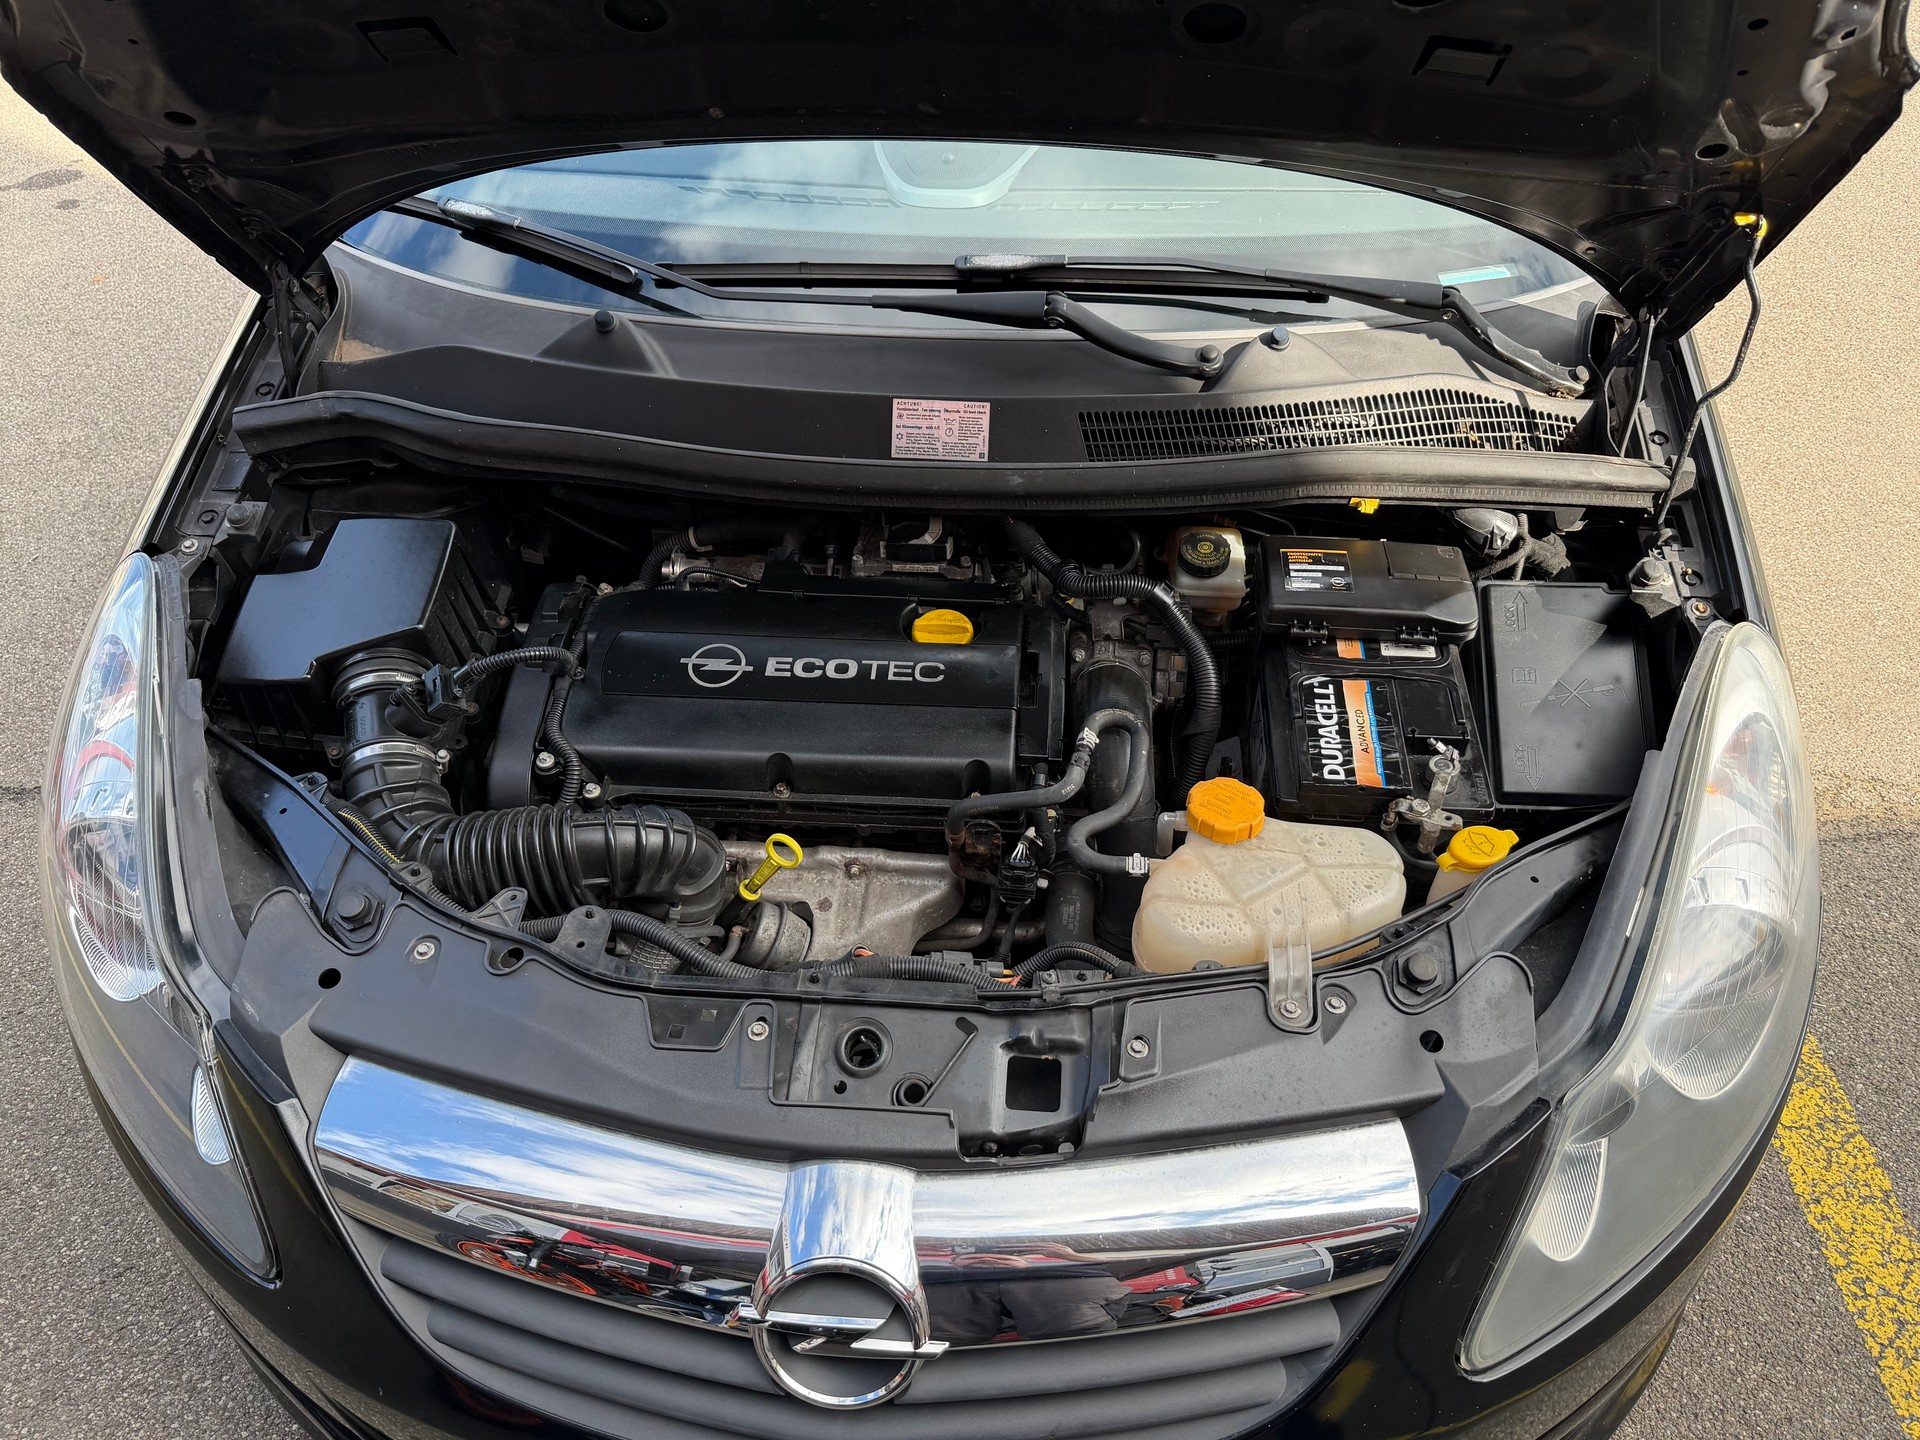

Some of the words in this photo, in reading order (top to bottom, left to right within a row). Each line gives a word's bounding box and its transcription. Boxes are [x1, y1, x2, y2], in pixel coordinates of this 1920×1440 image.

[1503, 605, 1515, 633] LOCK
[764, 655, 946, 684] ECOTEC
[1313, 684, 1346, 780] DURACELL
[1355, 709, 1370, 754] ADVANCED
[1514, 743, 1527, 774] LOCK
